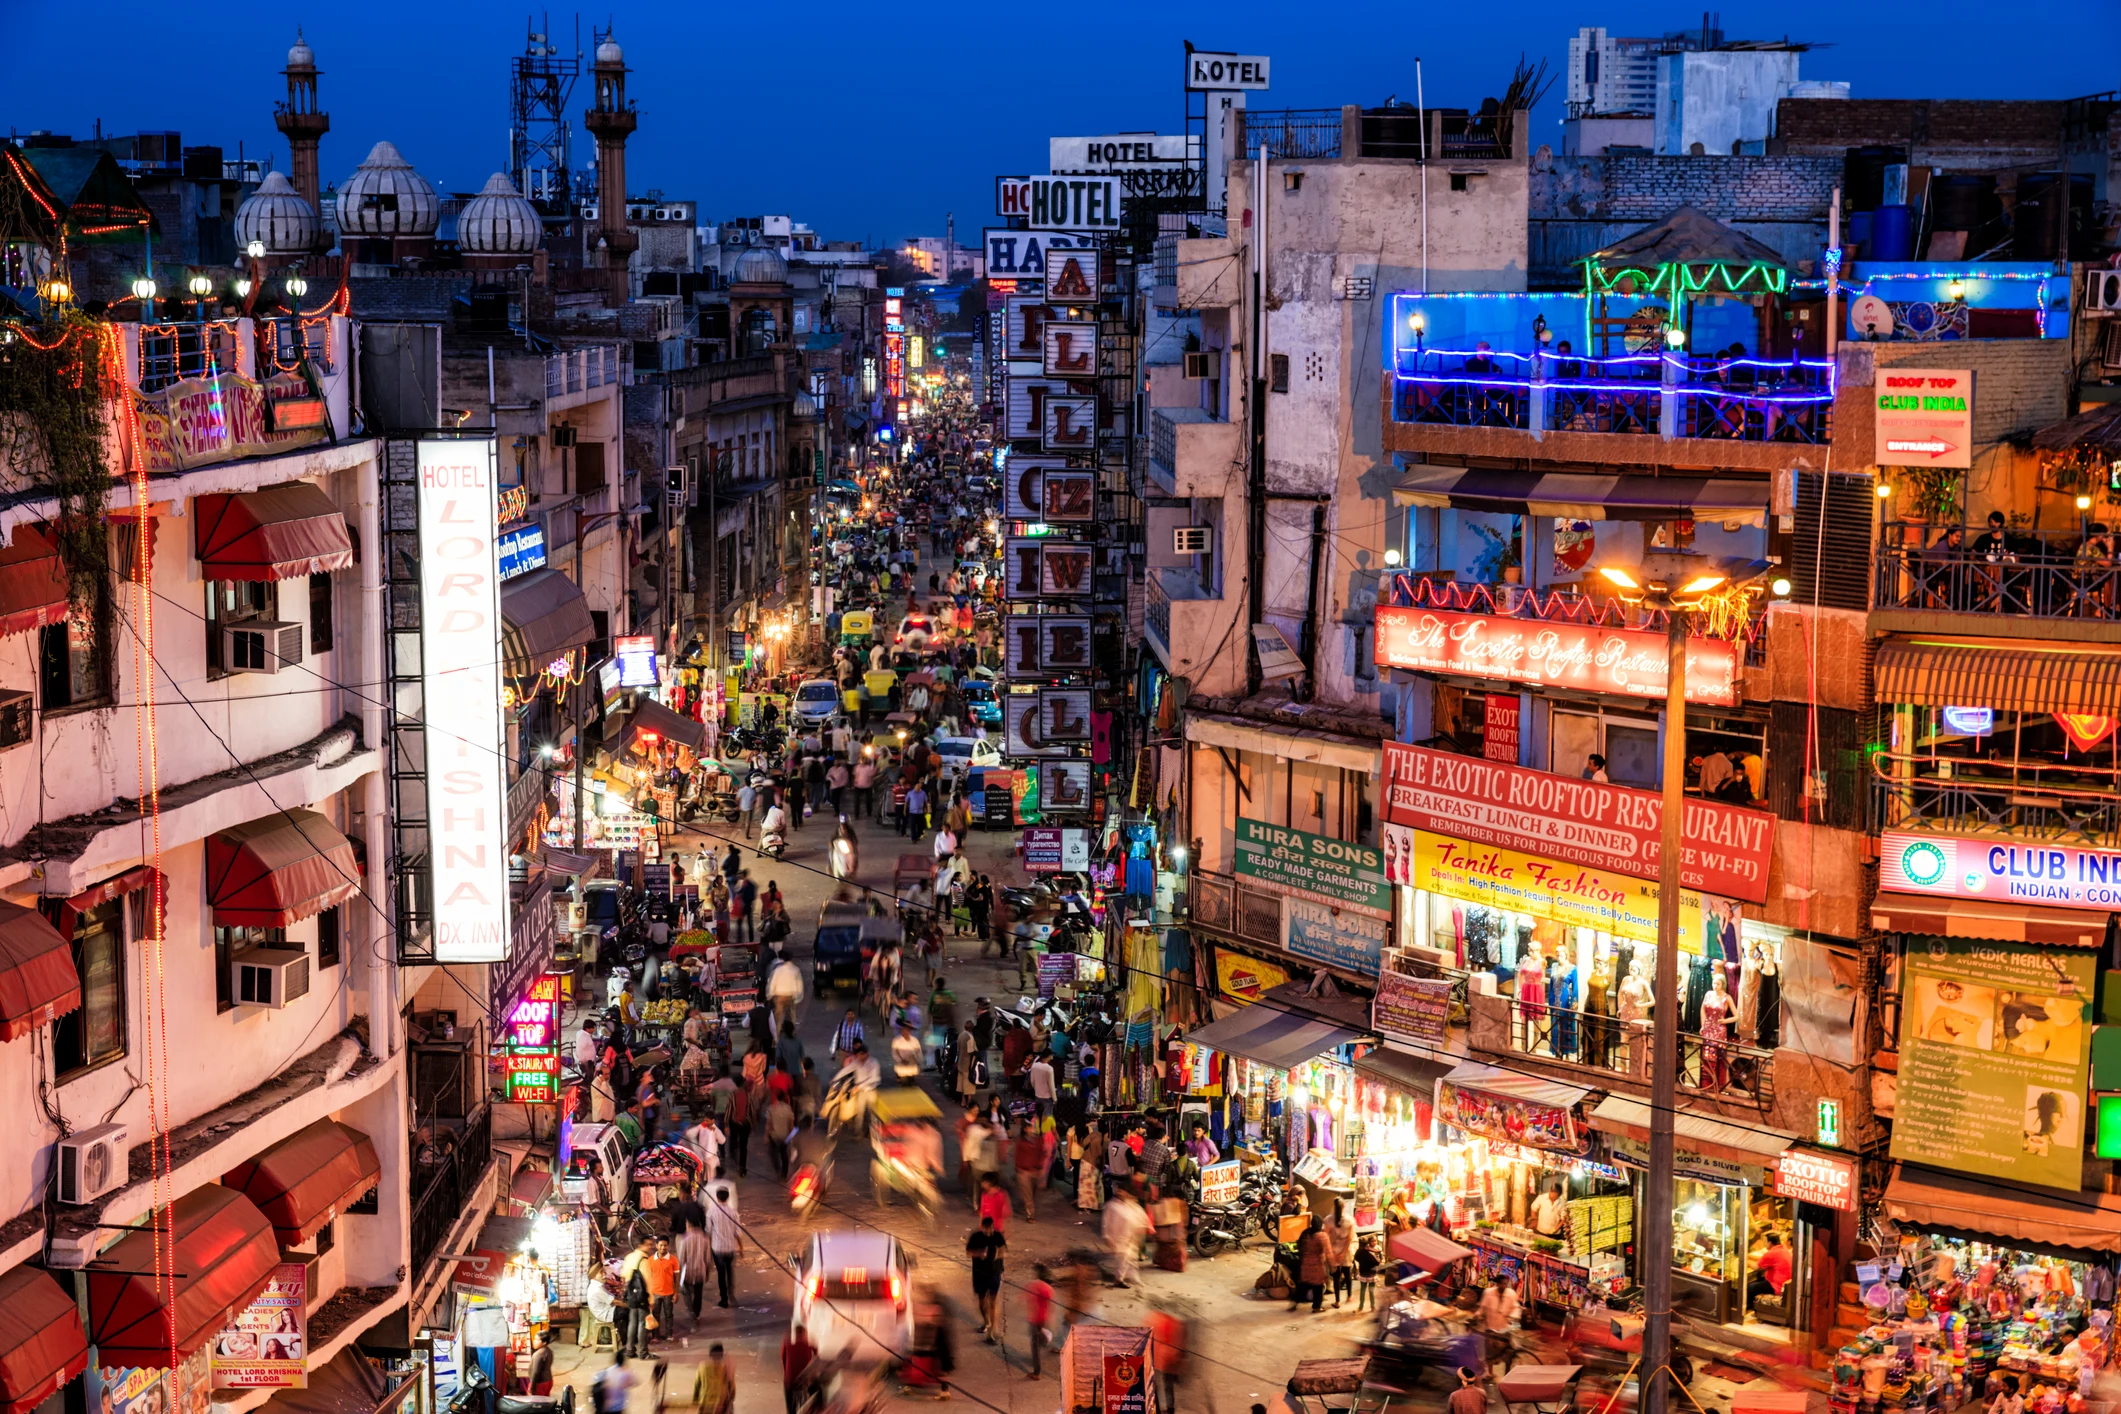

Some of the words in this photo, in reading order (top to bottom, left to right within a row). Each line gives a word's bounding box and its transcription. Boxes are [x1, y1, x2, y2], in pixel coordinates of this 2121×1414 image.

[1194, 60, 1266, 83] HOTEL
[1088, 143, 1160, 163] HOTEL
[1032, 180, 1118, 226] HOTEL
[1886, 377, 1925, 388] ROOF
[1928, 378, 1957, 388] TOP
[1878, 395, 1919, 410] CLUB
[1923, 396, 1967, 411] INDIA
[1887, 441, 1945, 452] ENTRANCE
[423, 465, 485, 489] HOTEL
[499, 533, 519, 560] ooftop
[505, 563, 523, 579] Lunch
[523, 559, 530, 572] &
[529, 555, 546, 571] Dinner
[1408, 614, 1448, 649] The
[1450, 619, 1525, 661] Exotic
[1528, 628, 1593, 679] Rooftop
[1594, 635, 1697, 686] Restaurt
[1389, 652, 1419, 666] Delicious
[1420, 656, 1447, 668] Western
[1448, 659, 1465, 670] Food
[1472, 663, 1508, 678] Hospitality
[1510, 667, 1540, 680] Services
[1626, 683, 1668, 697] COMPLIMENTA
[1487, 707, 1519, 727] EXOT
[1387, 748, 1428, 785] THE
[1431, 756, 1505, 801] EXOTIC
[1508, 772, 1612, 822] ROOFTOP
[1615, 793, 1769, 852] RESURANT
[1027, 841, 1060, 849] турагентство
[1033, 830, 1054, 840] Дипак
[1249, 823, 1305, 850] HIRA
[1312, 839, 1378, 867] SONS
[1392, 788, 1483, 820] BREAKFAST
[1486, 809, 1541, 834] LUNCH
[1546, 821, 1560, 838] &
[1563, 823, 1633, 853] DINNER
[1701, 850, 1758, 882] WI-FI)
[1270, 846, 1305, 864] हीरा
[1429, 817, 1494, 842] REMEMBER
[1496, 830, 1511, 846] US
[1513, 836, 1536, 852] FOR
[1539, 841, 1606, 865] DELICIOUS
[1606, 855, 1642, 873] FOOD
[1644, 864, 1704, 886] SECES
[1248, 853, 1281, 871] READY
[1283, 862, 1314, 879] MADE
[1316, 871, 1378, 895] GARMENTS
[1988, 845, 2066, 881] CLUB
[1254, 868, 1261, 876] A
[1262, 869, 1307, 888] COMPLETE
[1311, 882, 1342, 897] FAMILY
[1343, 890, 1368, 903] SHOP
[1436, 843, 1514, 880] Tanika
[1526, 861, 1626, 907] Fashion
[1246, 876, 1289, 894] SUMMER
[1291, 887, 1299, 896] &
[1301, 890, 1342, 907] WINTER
[1344, 901, 1378, 916] WEAR
[1431, 867, 1453, 881] Deals
[1454, 873, 1465, 884] In:
[1468, 876, 1488, 891] High
[1490, 881, 1522, 897] Fashion
[1523, 888, 1555, 905] Sequins
[1556, 896, 1598, 914] Garments
[1600, 906, 1622, 921] Belly
[1624, 913, 1652, 927] Dance
[1641, 887, 1650, 897] M.
[2009, 881, 2070, 899] INDIAN
[1289, 901, 1332, 927] HIRA
[1334, 913, 1384, 941] SONS
[438, 920, 466, 946] DX.
[470, 921, 500, 945] INN
[1956, 958, 2003, 971] AYURVEDIC
[2005, 966, 2043, 977] THERAPY
[1971, 945, 2008, 964] VEDIC
[2011, 953, 2067, 972] HEALERS
[1231, 978, 1244, 988] GOLD
[1244, 976, 1257, 986] FLAKE
[516, 1025, 545, 1044] TOP
[515, 1072, 548, 1086] FREE
[517, 1087, 548, 1100] WI-FI
[1112, 1146, 1119, 1157] 7
[1793, 1152, 1823, 1165] WELCOME
[1677, 1155, 1702, 1164] GOLD
[1712, 1160, 1741, 1173] SILVER
[1779, 1157, 1849, 1187] EXOTIC
[1202, 1170, 1220, 1187] HIRA
[1220, 1166, 1239, 1183] SONS
[1784, 1174, 1841, 1196] ROOFTOP
[1777, 1183, 1847, 1208] RESTAURANT
[462, 1270, 495, 1281] vodafone
[129, 1372, 143, 1394] SPA
